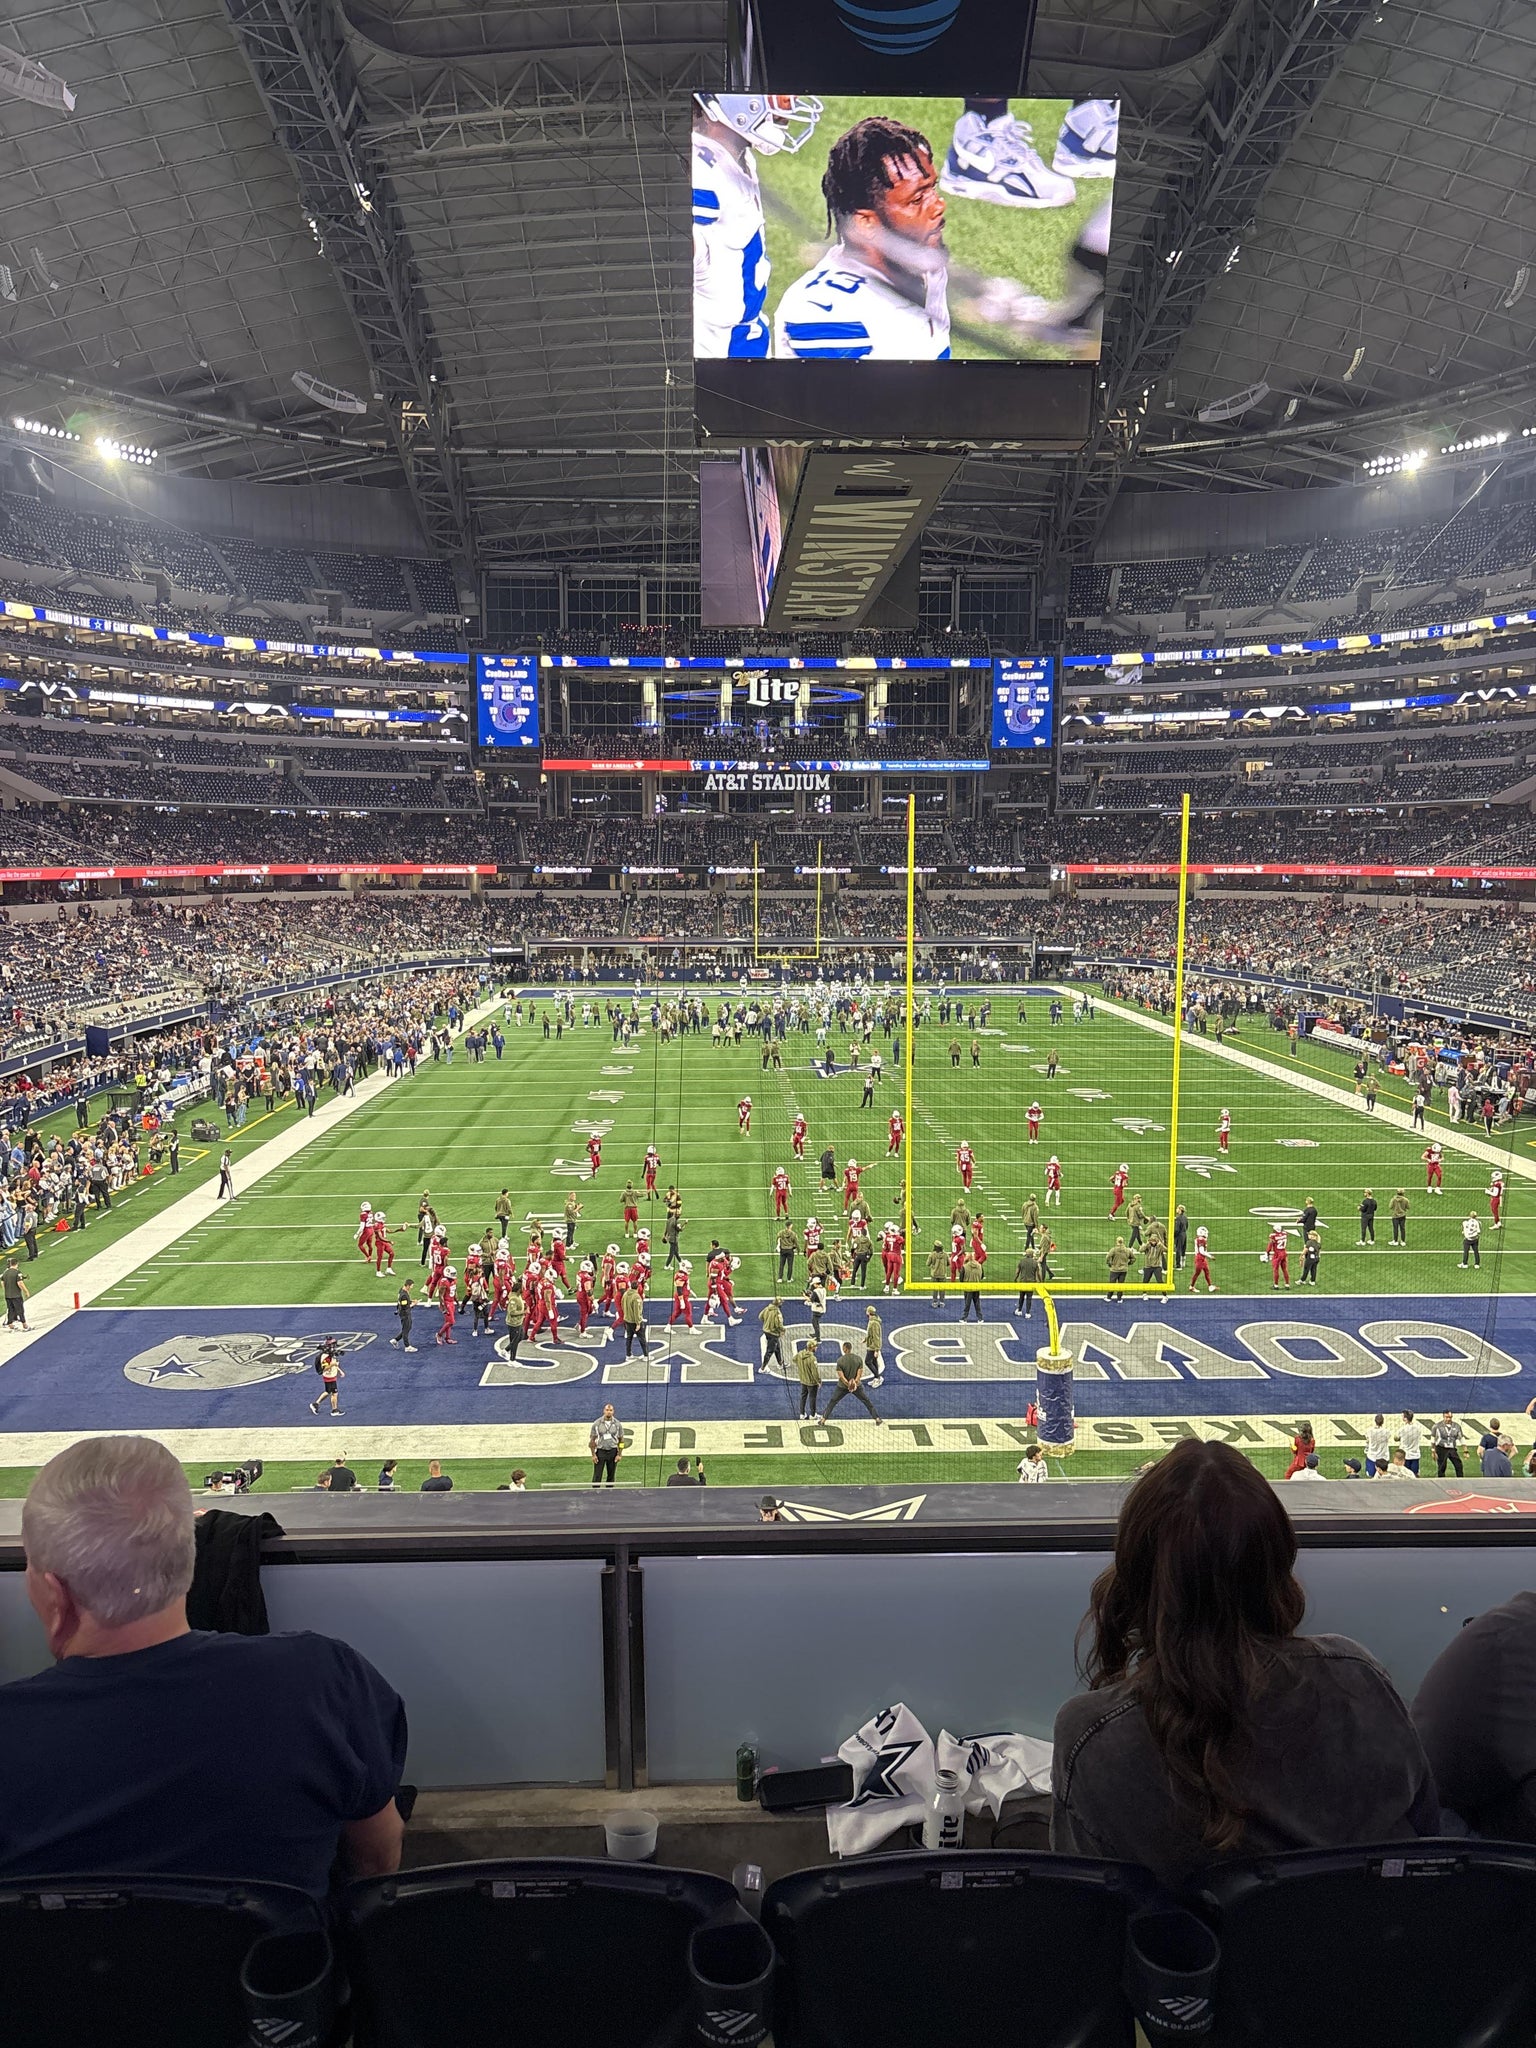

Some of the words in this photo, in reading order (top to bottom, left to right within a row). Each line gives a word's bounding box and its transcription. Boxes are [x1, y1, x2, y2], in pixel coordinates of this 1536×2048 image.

[806, 270, 867, 294] 13
[765, 439, 1024, 450] WINSTAR
[782, 499, 922, 617] WINSTAR
[147, 662, 175, 670] SCHRAMM
[746, 677, 799, 707] Lite
[710, 761, 715, 769] 0
[816, 761, 822, 769] 0
[704, 773, 748, 790] AT&T
[752, 774, 830, 790] STADIUM
[541, 866, 592, 874] Blockchain.com
[629, 866, 680, 874] Blockchain.com
[715, 866, 765, 874] Blockchain.com
[571, 1119, 615, 1133] 30
[960, 1153, 970, 1162] 45
[849, 1173, 858, 1182] 19
[777, 1181, 787, 1190] 31
[852, 1229, 862, 1237] 80
[888, 1241, 894, 1252] 7
[434, 1255, 442, 1265] 10
[479, 1321, 1522, 1387] COWBOYS
[743, 1425, 846, 1449] OF
